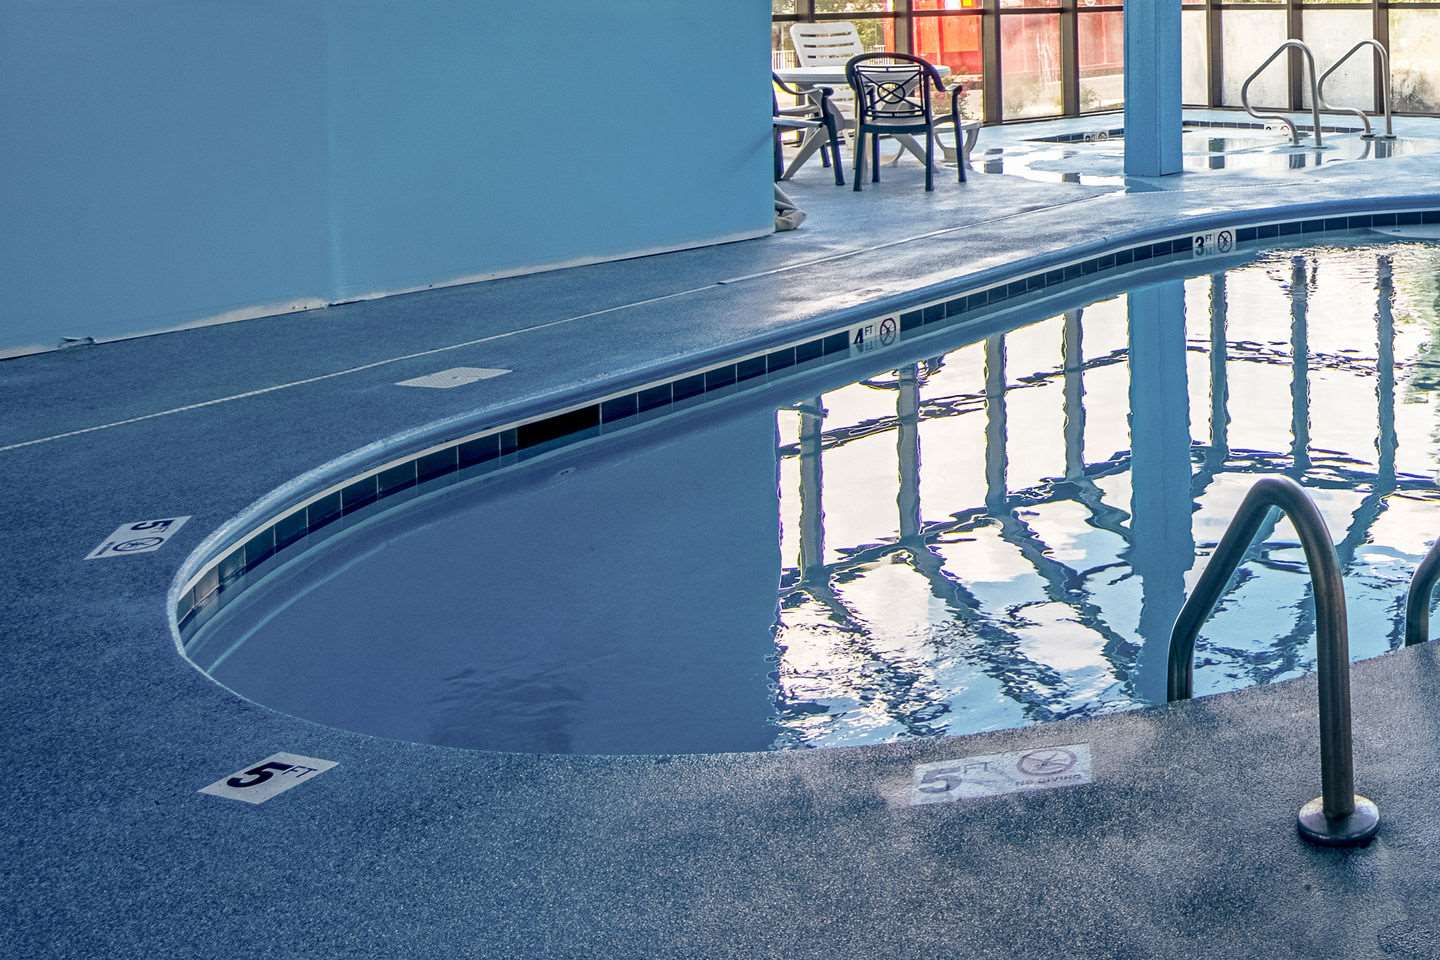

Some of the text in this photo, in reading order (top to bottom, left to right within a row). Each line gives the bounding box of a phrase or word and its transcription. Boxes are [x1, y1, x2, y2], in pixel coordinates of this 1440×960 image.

[864, 325, 874, 337] FT
[130, 519, 174, 531] 5
[226, 761, 319, 788] 5 FT
[917, 766, 963, 794] 5
